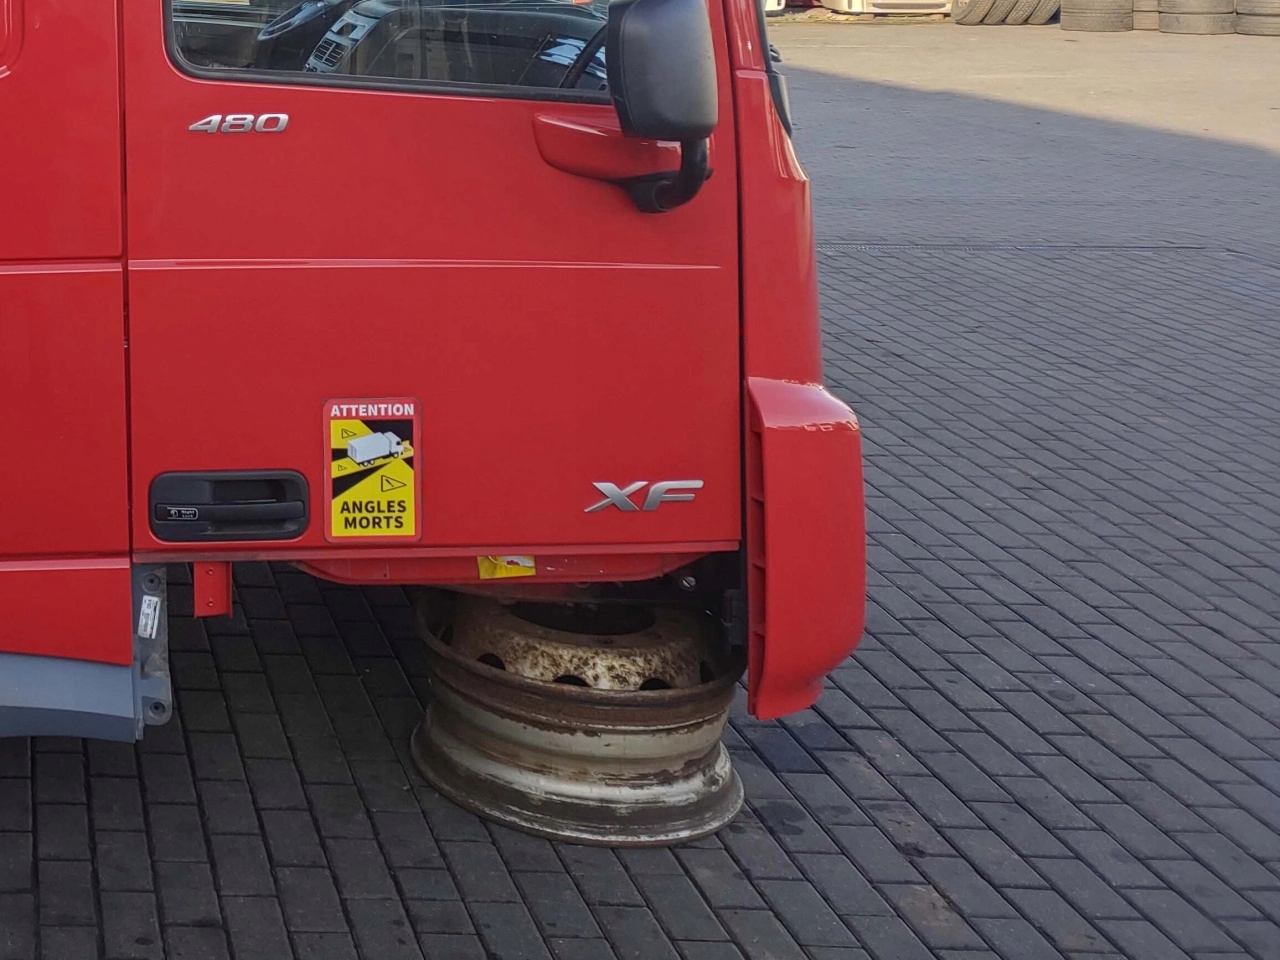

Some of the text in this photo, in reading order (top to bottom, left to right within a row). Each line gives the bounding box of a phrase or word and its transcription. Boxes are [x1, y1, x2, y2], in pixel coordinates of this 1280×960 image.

[188, 113, 289, 133] 480
[330, 403, 414, 417] ATTENTION
[584, 479, 704, 512] XF
[340, 500, 407, 514] ANGLES
[344, 516, 404, 529] MORTS
